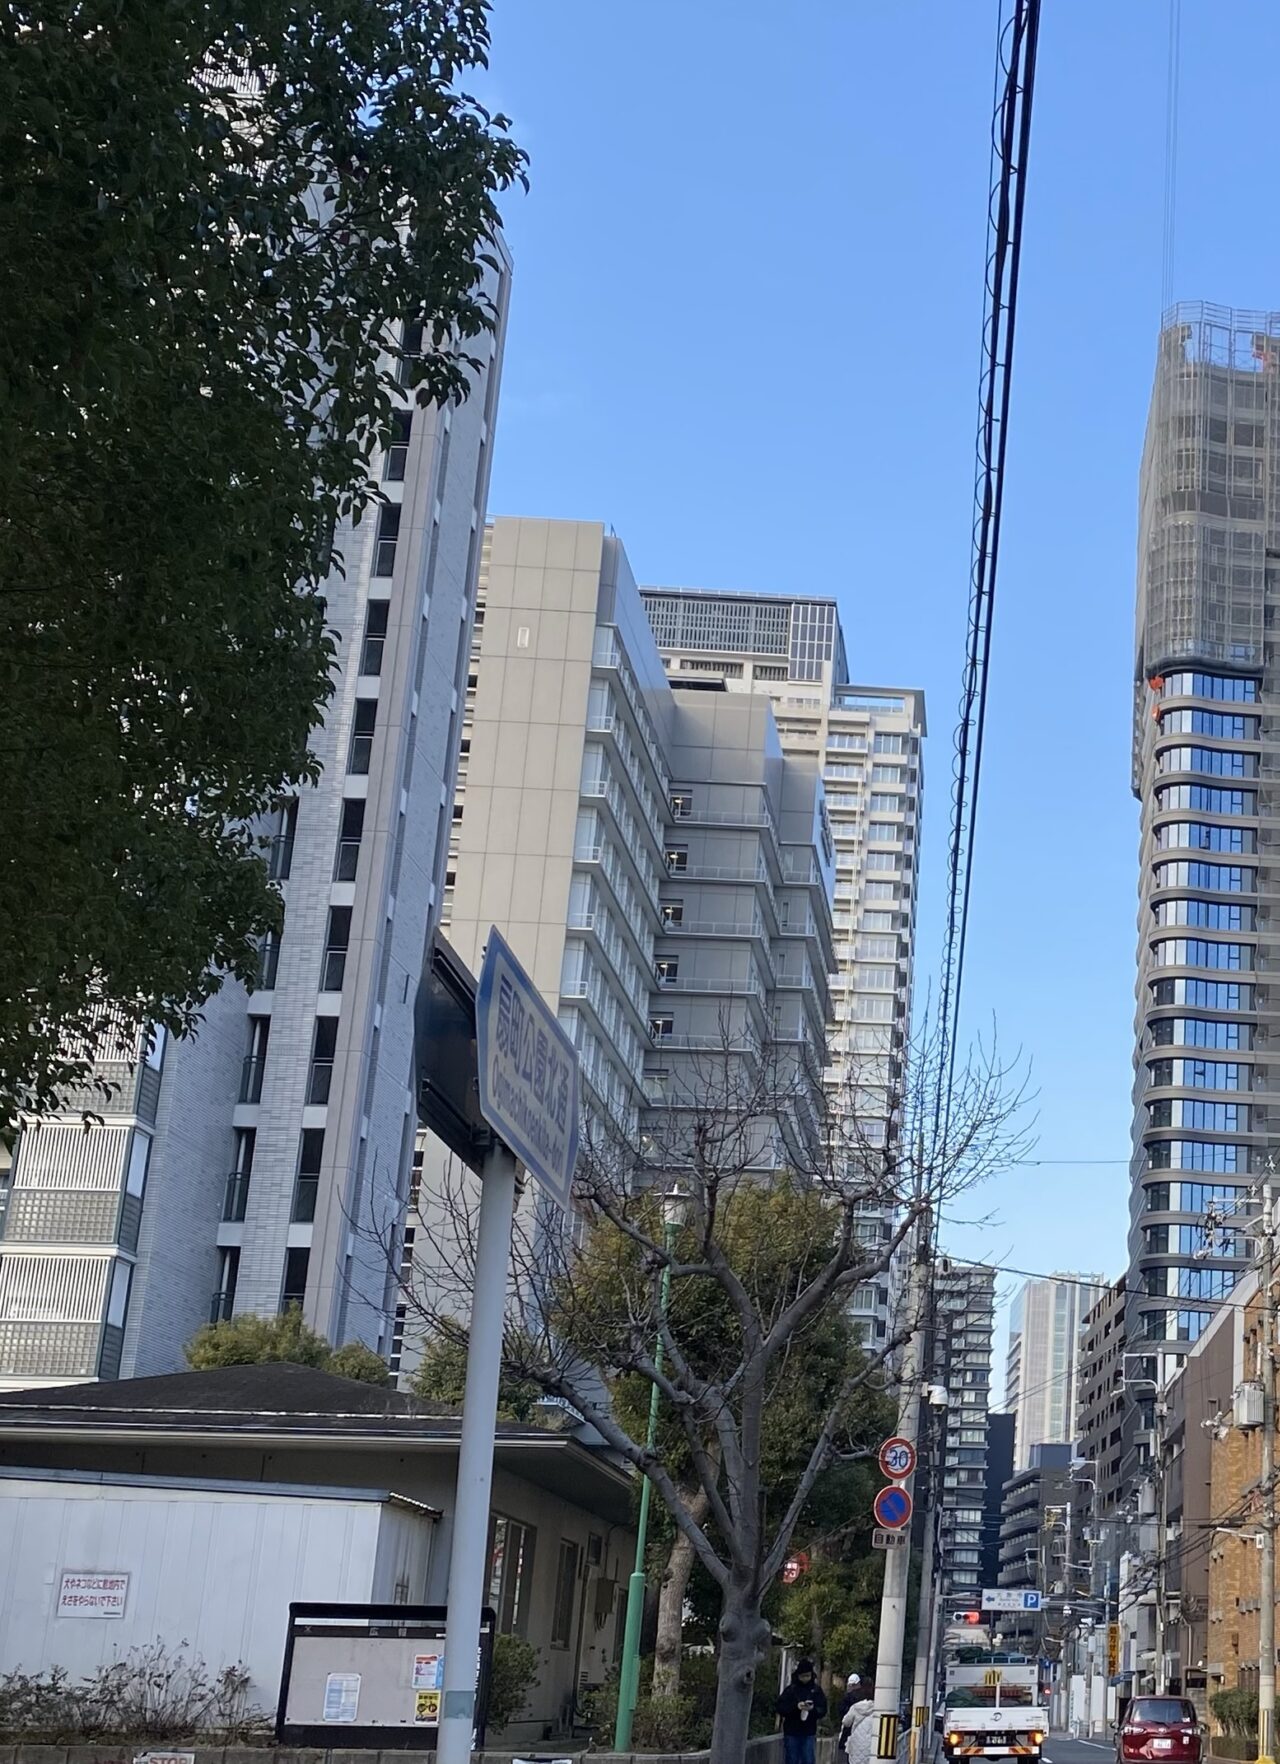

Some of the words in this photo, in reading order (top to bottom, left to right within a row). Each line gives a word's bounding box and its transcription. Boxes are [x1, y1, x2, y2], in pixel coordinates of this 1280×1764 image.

[495, 974, 569, 1134] 扇町公園北通
[889, 1449, 908, 1467] 30
[874, 1534, 905, 1545] 自動車
[61, 1595, 122, 1607] えさをやらないで下さい
[1028, 1594, 1036, 1606] P
